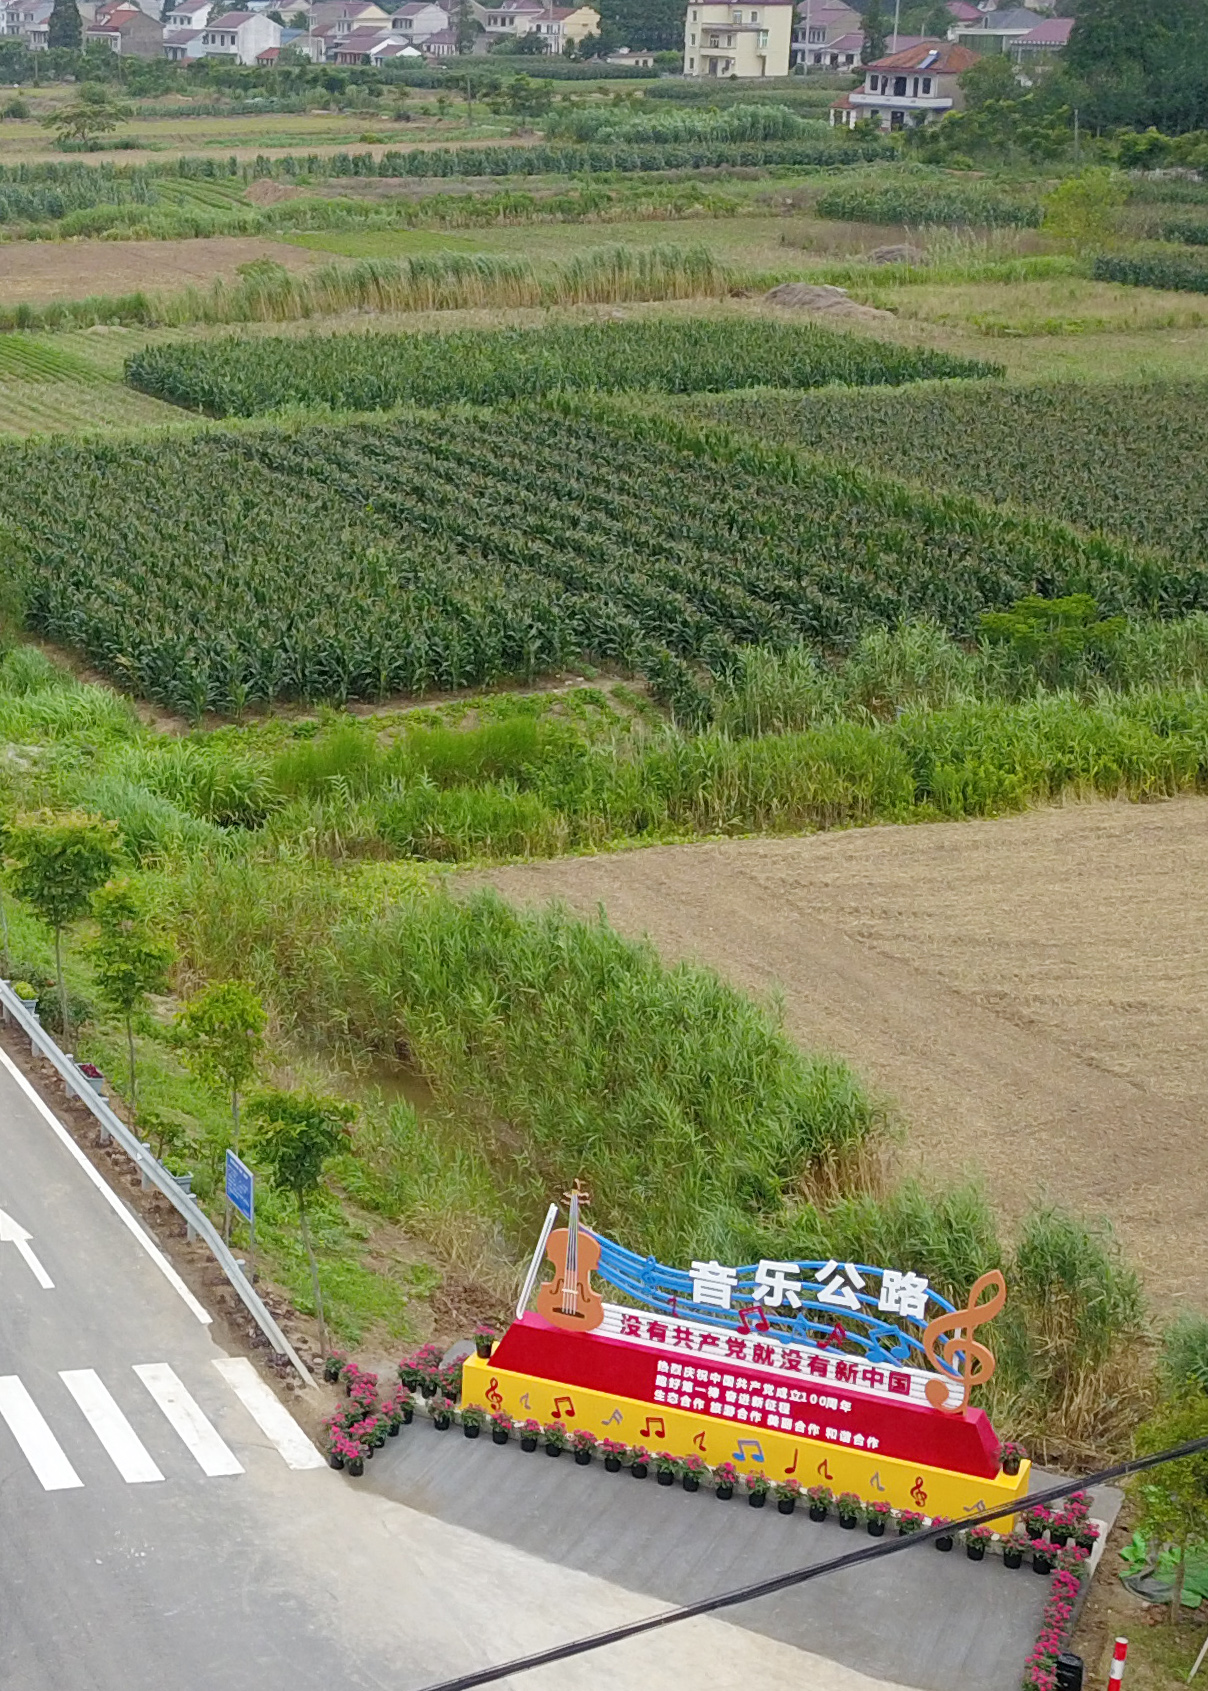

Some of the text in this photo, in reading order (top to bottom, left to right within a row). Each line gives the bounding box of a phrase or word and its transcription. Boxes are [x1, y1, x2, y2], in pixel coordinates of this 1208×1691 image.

[689, 1259, 929, 1319] 音乐公路
[620, 1314, 911, 1396] 没有共产党就没有新中国
